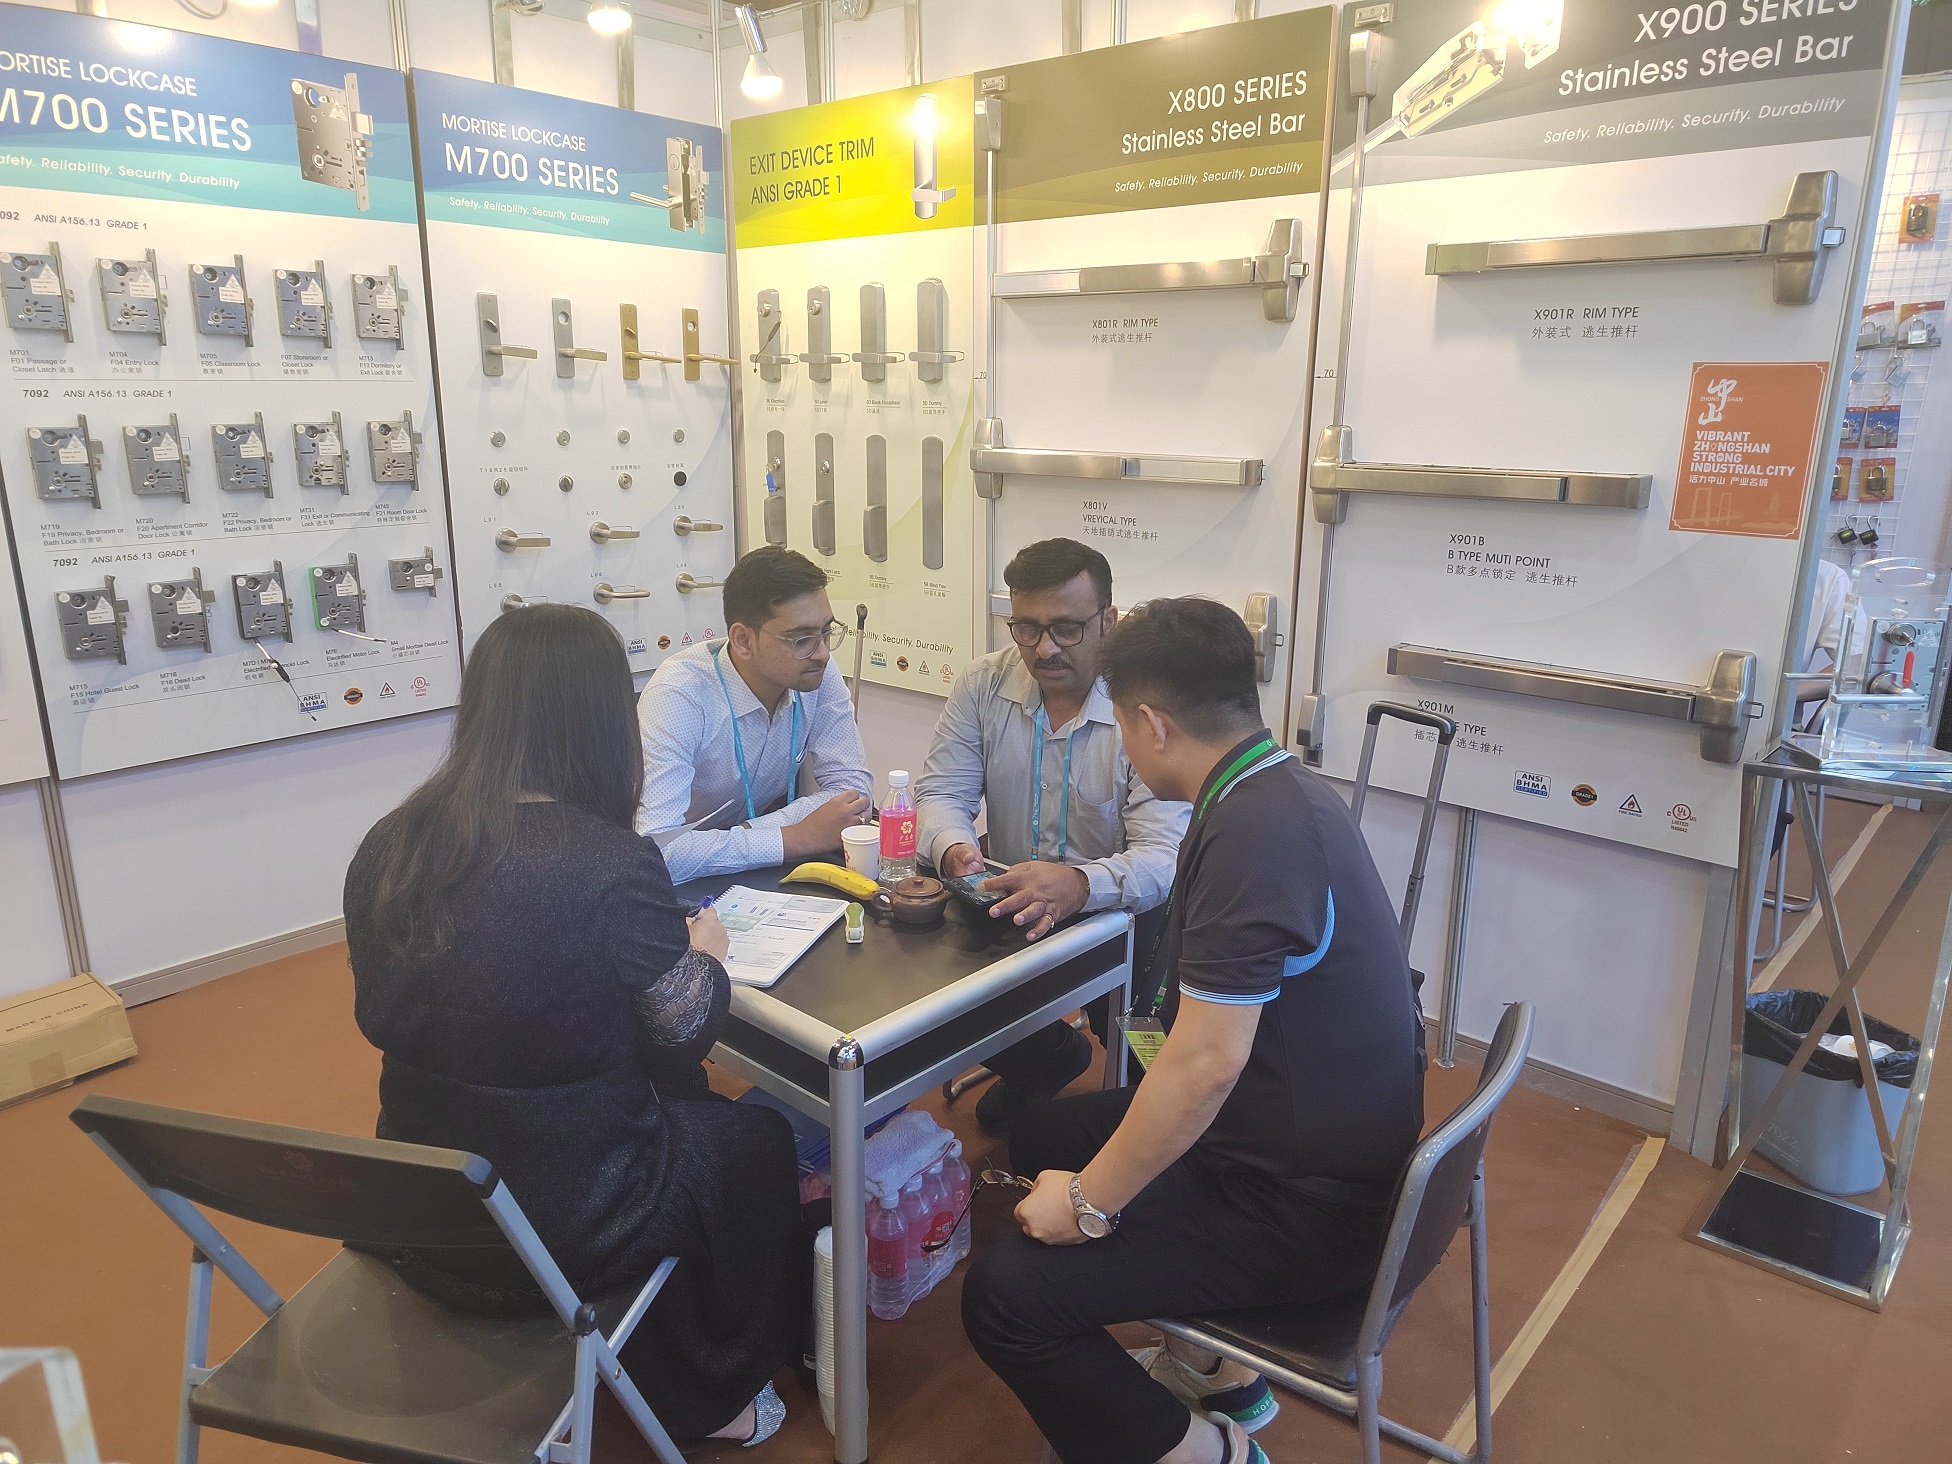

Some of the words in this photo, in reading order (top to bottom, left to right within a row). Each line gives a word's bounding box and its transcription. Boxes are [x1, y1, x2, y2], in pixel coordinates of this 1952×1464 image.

[1634, 0, 1727, 43] X900
[1558, 57, 1688, 96] Stainless
[1699, 39, 1782, 77] Steel
[1794, 34, 1853, 63] Bar
[79, 61, 198, 97] LOCKCASE
[1167, 83, 1226, 115] X800
[1233, 69, 1307, 105] SERIES
[124, 103, 252, 152] SERIES
[1543, 128, 1590, 144] Safety.
[1596, 117, 1675, 138] Reliability.
[1681, 108, 1751, 128] Security.
[1757, 97, 1846, 120] Durability
[442, 113, 507, 138] MORTISE
[511, 125, 586, 152] LOCKCASE
[1121, 127, 1204, 155] Stainless
[1210, 115, 1262, 143] Steel
[1269, 112, 1306, 135] Bar
[750, 152, 775, 176] EXIT
[781, 143, 834, 171] DEVICE
[839, 136, 875, 162] TRIM
[41, 157, 113, 176] Reliability.
[118, 165, 175, 183] Security.
[179, 172, 240, 190] Durability
[445, 142, 528, 182] M700
[538, 157, 619, 195] SERIES
[1114, 180, 1145, 193] Safety.
[1148, 173, 1198, 189] Reliability.
[1202, 168, 1245, 183] Security.
[1249, 161, 1304, 177] Durability
[751, 183, 779, 205] ANSI
[783, 176, 830, 200] GRADE
[836, 175, 842, 194] 1
[449, 196, 481, 210] Safety.
[483, 201, 530, 216] Reliability.
[532, 207, 568, 221] Security.
[570, 213, 610, 227] Durability
[34, 213, 57, 223] ANSI
[60, 216, 101, 227] A156.13
[106, 219, 140, 231] GRADE
[142, 222, 148, 231] 1
[1534, 308, 1575, 321] X901R
[1582, 307, 1607, 320] RIM
[1611, 306, 1640, 319] TYPE
[1092, 319, 1118, 329] X801R
[1123, 318, 1138, 328] RIM
[1141, 318, 1159, 328] TYPE
[1531, 325, 1571, 340] 外装式
[1582, 324, 1640, 339] 逃生推杆
[27, 357, 58, 365] Passage
[1324, 368, 1335, 379] 70
[22, 389, 50, 398] 7092
[63, 389, 85, 398] ANSI
[88, 389, 127, 398] A156.13
[133, 389, 164, 398] GRADE
[167, 389, 173, 398] 1
[1696, 430, 1751, 442] VIBRANT
[1692, 452, 1742, 463] STRONG
[1690, 462, 1764, 476] INDUSTRIAL
[1766, 465, 1796, 477] CITY
[1689, 474, 1725, 485] 活力中山
[1729, 476, 1769, 487] 产业名城
[1082, 500, 1108, 511] X801V
[40, 523, 61, 531] M719
[151, 523, 183, 531] Apartment
[1120, 516, 1137, 526] TYPE
[86, 528, 116, 536] Bedroom
[1449, 533, 1485, 546] X901B
[53, 558, 78, 567] 7092
[91, 555, 113, 565] ANSI
[115, 552, 153, 562] A156.13
[157, 549, 188, 559] GRADE
[1448, 550, 1455, 559] B
[1458, 550, 1482, 562] TYPE
[1485, 553, 1512, 565] MUTI
[1515, 555, 1551, 569] POINT
[1446, 564, 1516, 581] B款多点锁定
[1525, 571, 1579, 588] 逃生推杆
[882, 633, 913, 648] Security.
[916, 639, 954, 655] Durability
[326, 654, 351, 662] Electrified
[352, 651, 368, 659] Motor
[159, 671, 178, 679] M716
[69, 683, 89, 691] M715
[85, 688, 103, 696] Hotel
[104, 686, 123, 694] Guest
[125, 683, 140, 691] Lock
[302, 694, 321, 702] ANSI
[1417, 699, 1454, 715] X901M
[1463, 723, 1487, 736] TYPE
[1456, 737, 1504, 756] 逃生推杆
[1516, 779, 1547, 791] BHMA
[1521, 773, 1543, 783] ANSI
[1671, 819, 1689, 827] LISTED
[6, 1020, 37, 1033] MADE
[56, 1003, 89, 1016] CHINA
